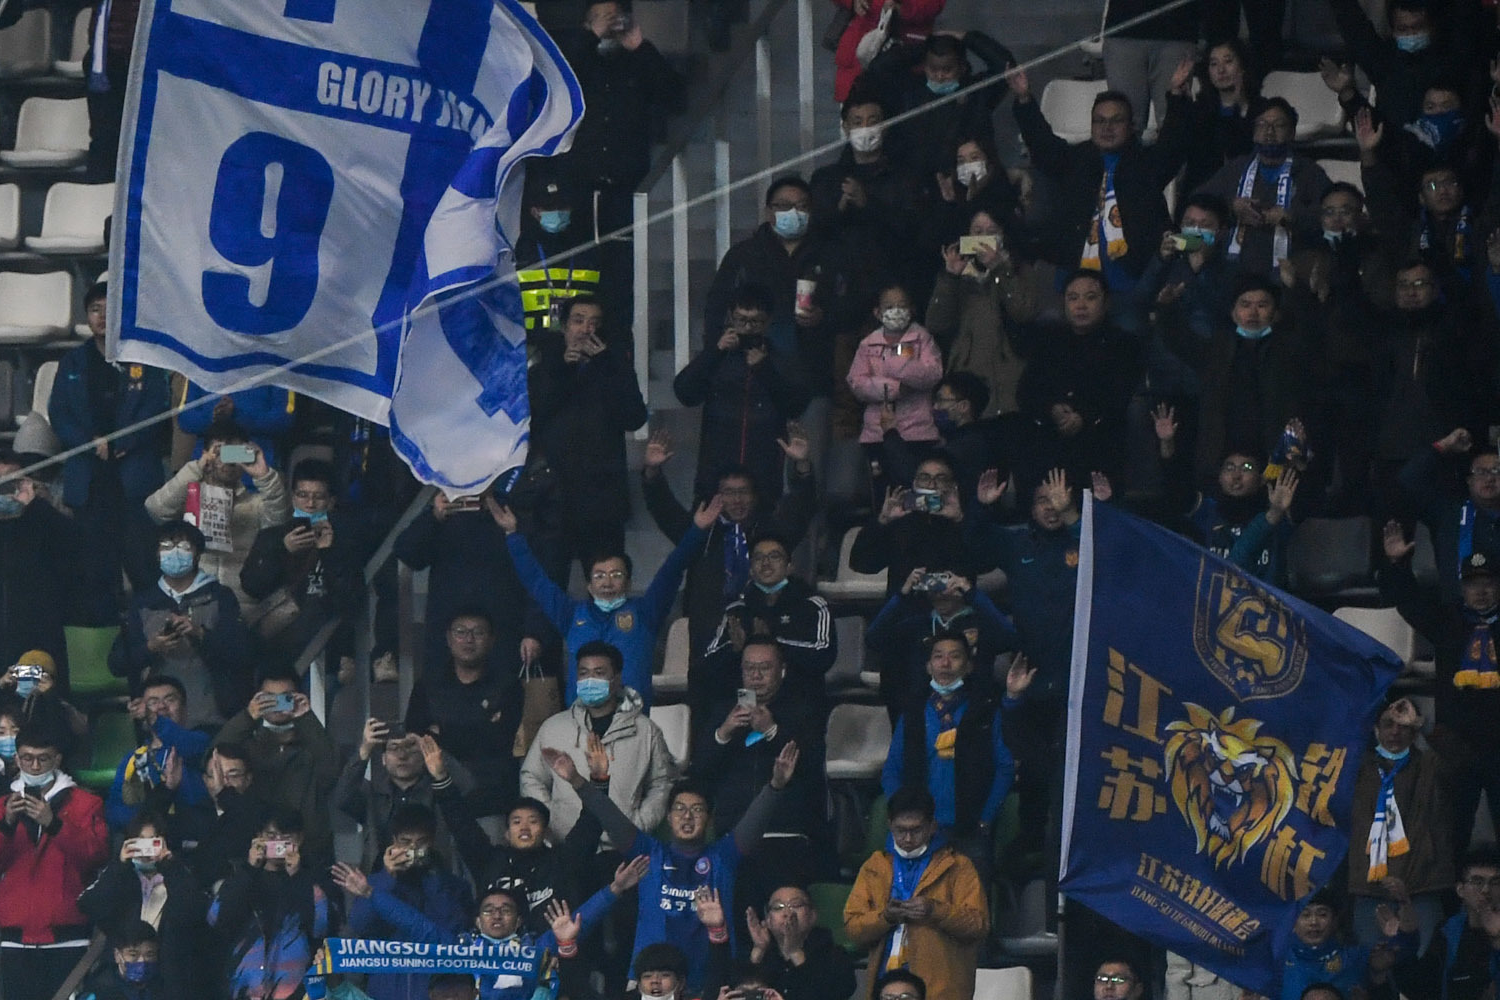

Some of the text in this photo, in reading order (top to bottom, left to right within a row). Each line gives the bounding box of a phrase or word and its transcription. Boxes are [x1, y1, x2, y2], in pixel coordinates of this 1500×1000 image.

[316, 62, 431, 123] GLORY
[201, 130, 335, 336] 9
[337, 938, 430, 956] JIANGSU
[339, 957, 533, 973] JIANGSU SUNING FOOTBALL CLUB
